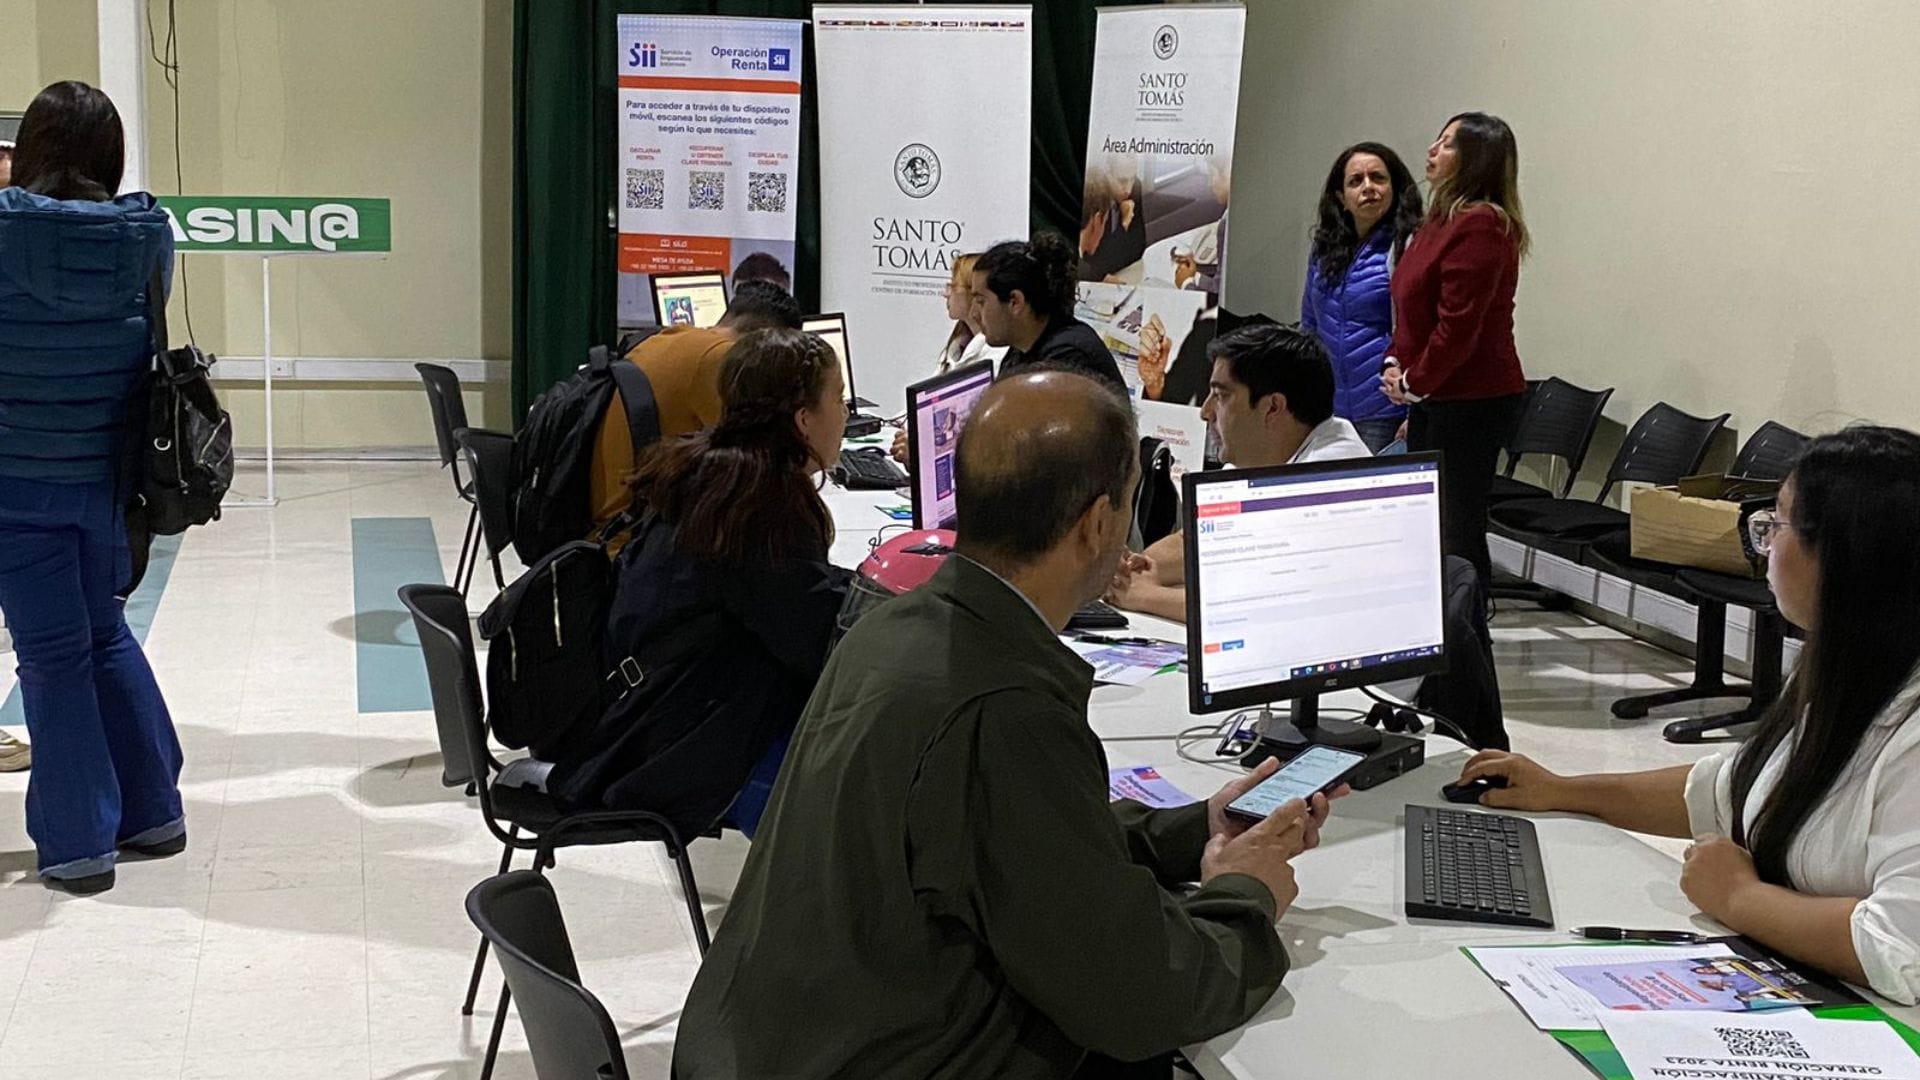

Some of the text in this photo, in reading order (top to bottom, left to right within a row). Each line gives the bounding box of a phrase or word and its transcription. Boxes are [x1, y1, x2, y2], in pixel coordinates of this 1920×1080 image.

[711, 45, 768, 59] Operación
[731, 58, 768, 71] Renta
[1139, 72, 1187, 88] SANTO
[1138, 88, 1184, 106] TOMÁS
[626, 100, 646, 109] Para
[648, 102, 683, 110] acceder
[692, 102, 718, 111] través
[720, 104, 730, 112] de
[732, 104, 741, 112] tu
[743, 104, 791, 114] dispositivo
[629, 111, 655, 121] móvil,
[695, 114, 707, 122] los
[709, 115, 752, 125] siguientes
[754, 116, 789, 126] códigos
[658, 124, 757, 136] según lo que necesites:
[1103, 135, 1214, 155] Área Administración
[872, 217, 962, 244] SANTO
[1664, 1056, 1882, 1075] OPERACIÓN RENTA 2023
